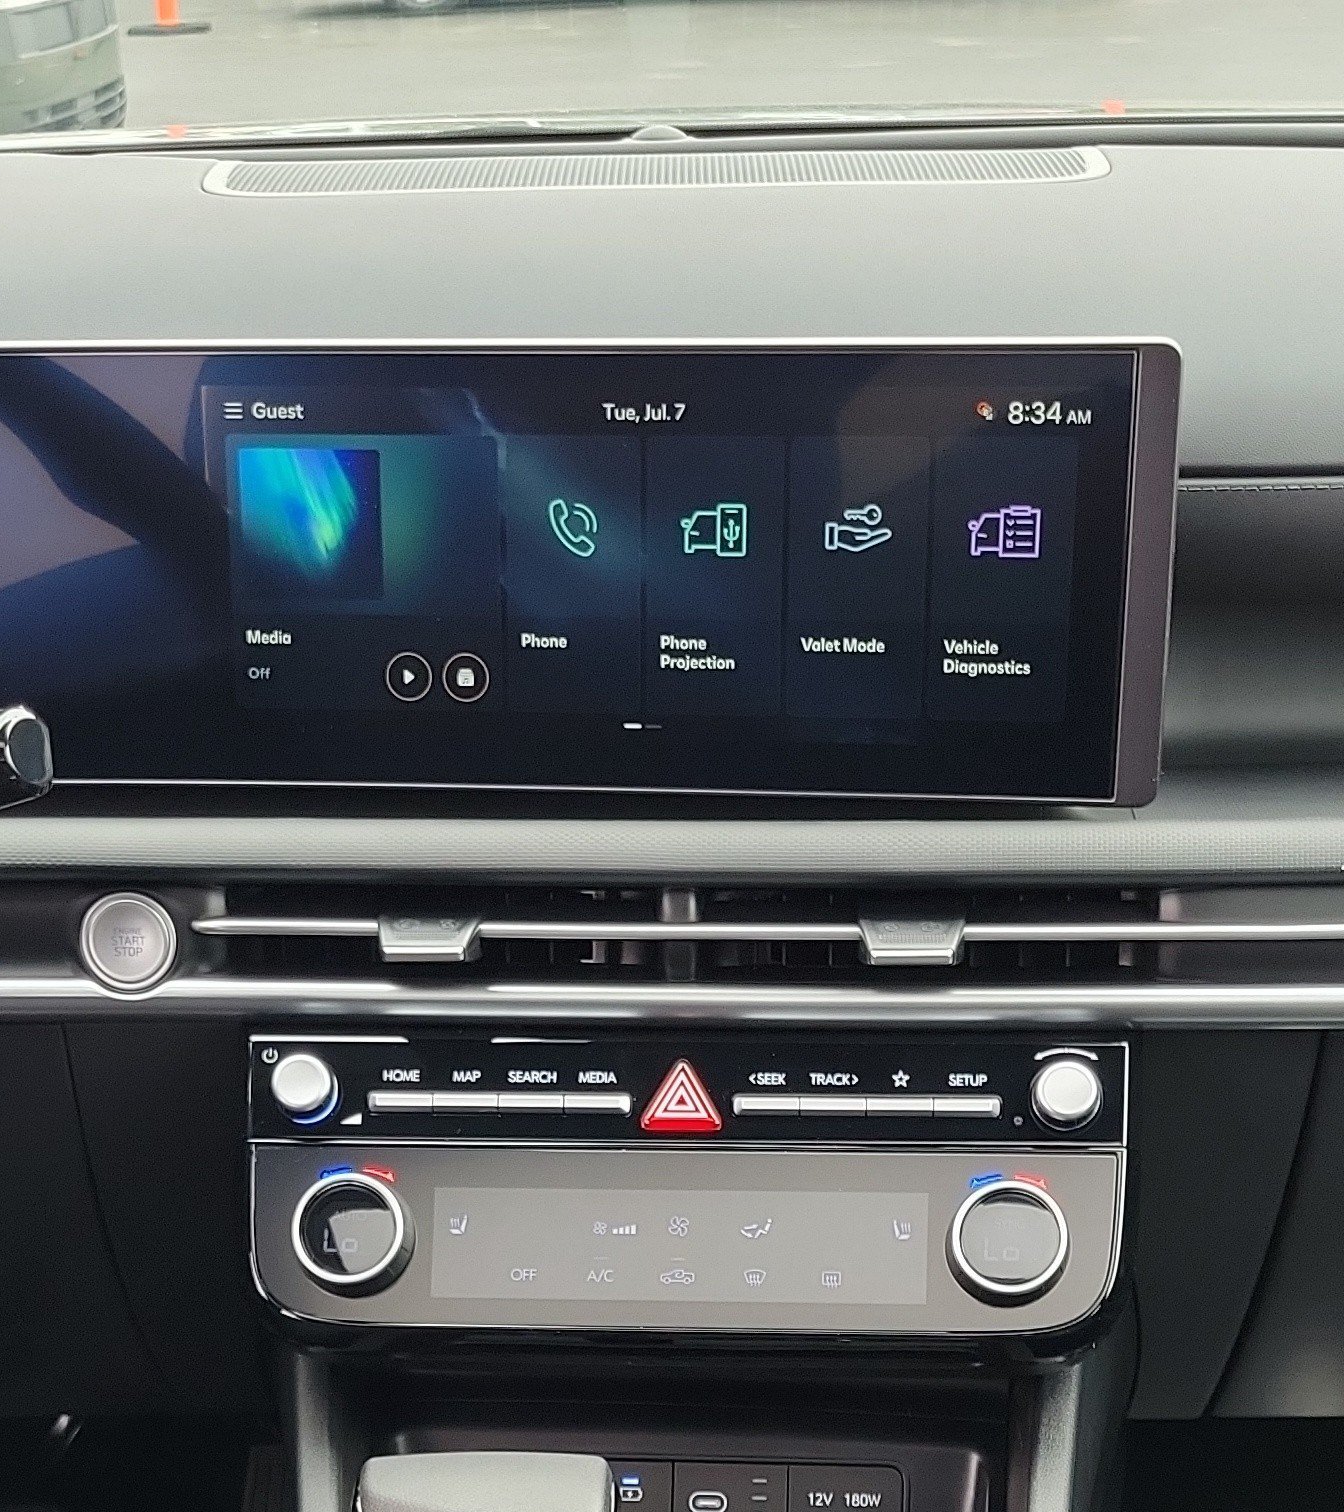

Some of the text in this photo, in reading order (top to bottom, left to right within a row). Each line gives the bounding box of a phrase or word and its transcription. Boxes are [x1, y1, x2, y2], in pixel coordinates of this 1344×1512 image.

[252, 402, 305, 421] Guest
[602, 403, 686, 423] Tue, Jul. 7
[1008, 401, 1092, 425] 8:34 AM
[246, 629, 292, 646] Media
[520, 633, 568, 650] Phone
[660, 635, 707, 651] Phone
[801, 637, 885, 654] Valet Mode
[944, 639, 999, 657] Vehicle
[660, 655, 735, 672] Projection
[943, 658, 1031, 677] Diagnostics
[248, 667, 271, 680] Off
[111, 936, 145, 947] START
[114, 947, 144, 957] STOP
[382, 1069, 421, 1083] HOME
[452, 1070, 482, 1083] MAP
[508, 1070, 558, 1084] SEARCH
[578, 1071, 618, 1085] MEDIA
[948, 1073, 988, 1088] SETUP
[510, 1268, 538, 1281] OFF
[587, 1268, 615, 1282] A/C
[808, 1492, 881, 1507] 12V 180W
